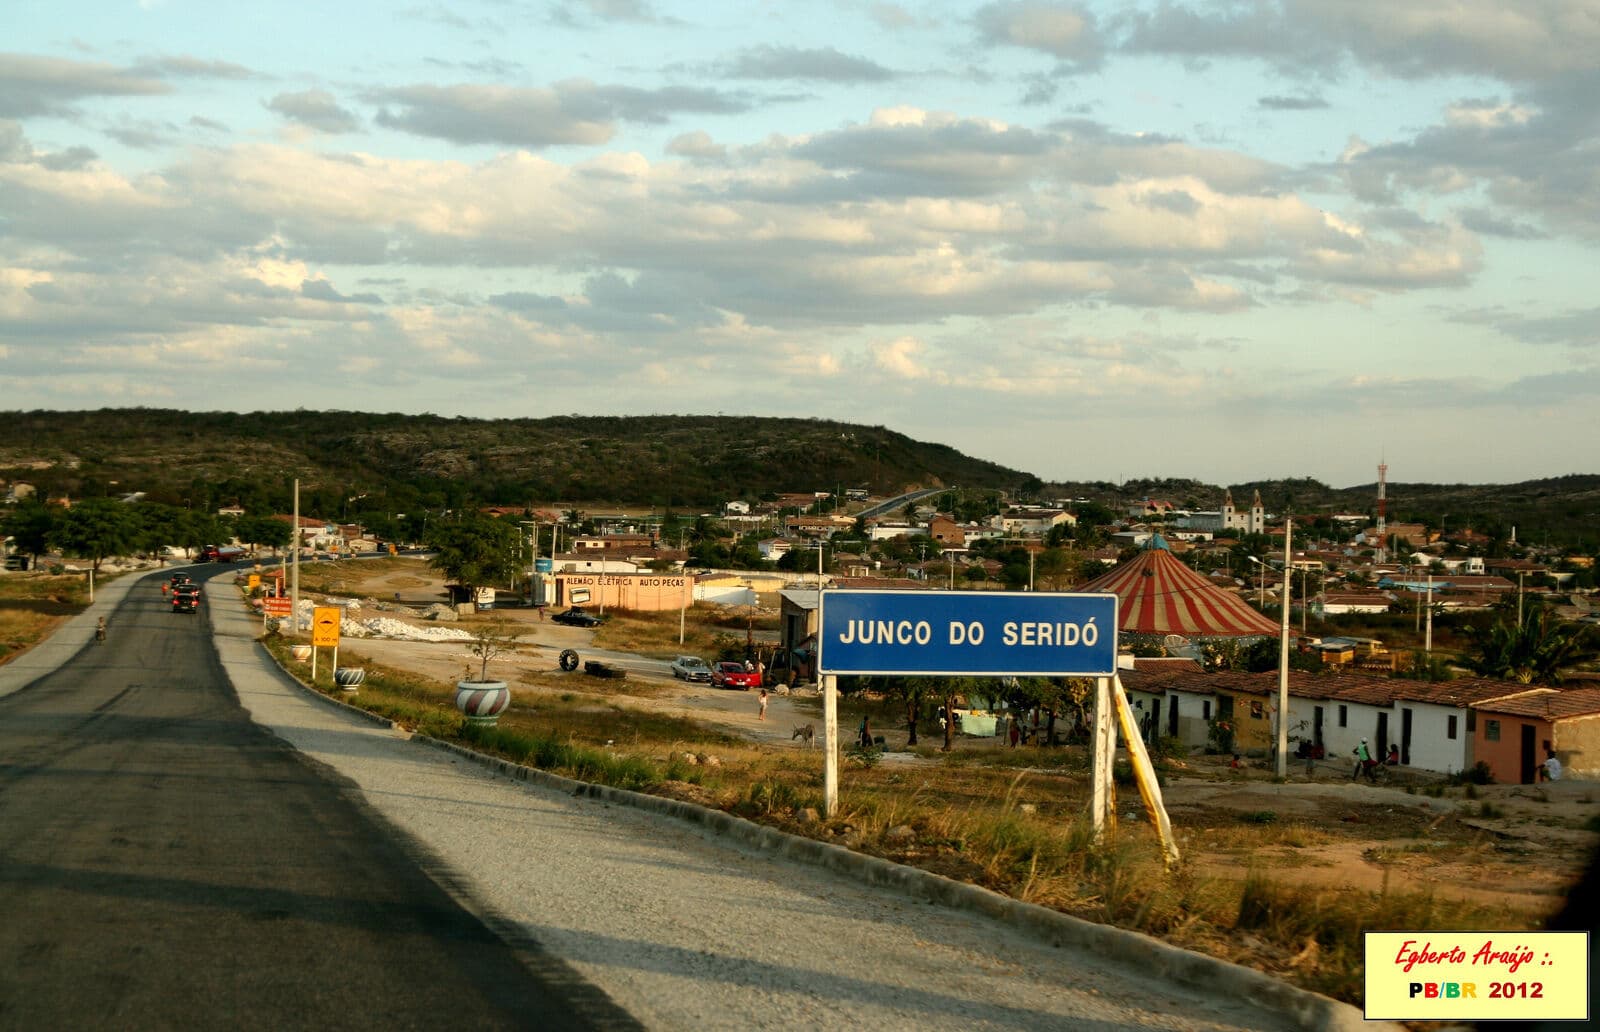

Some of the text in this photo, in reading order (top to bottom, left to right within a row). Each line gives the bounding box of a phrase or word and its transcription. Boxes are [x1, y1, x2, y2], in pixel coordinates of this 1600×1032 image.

[566, 577, 594, 585] ALEMÃO
[640, 579, 660, 587] AUTO
[662, 578, 685, 588] PEÇAS
[839, 616, 1099, 646] JUNCO DO SERIDÓ
